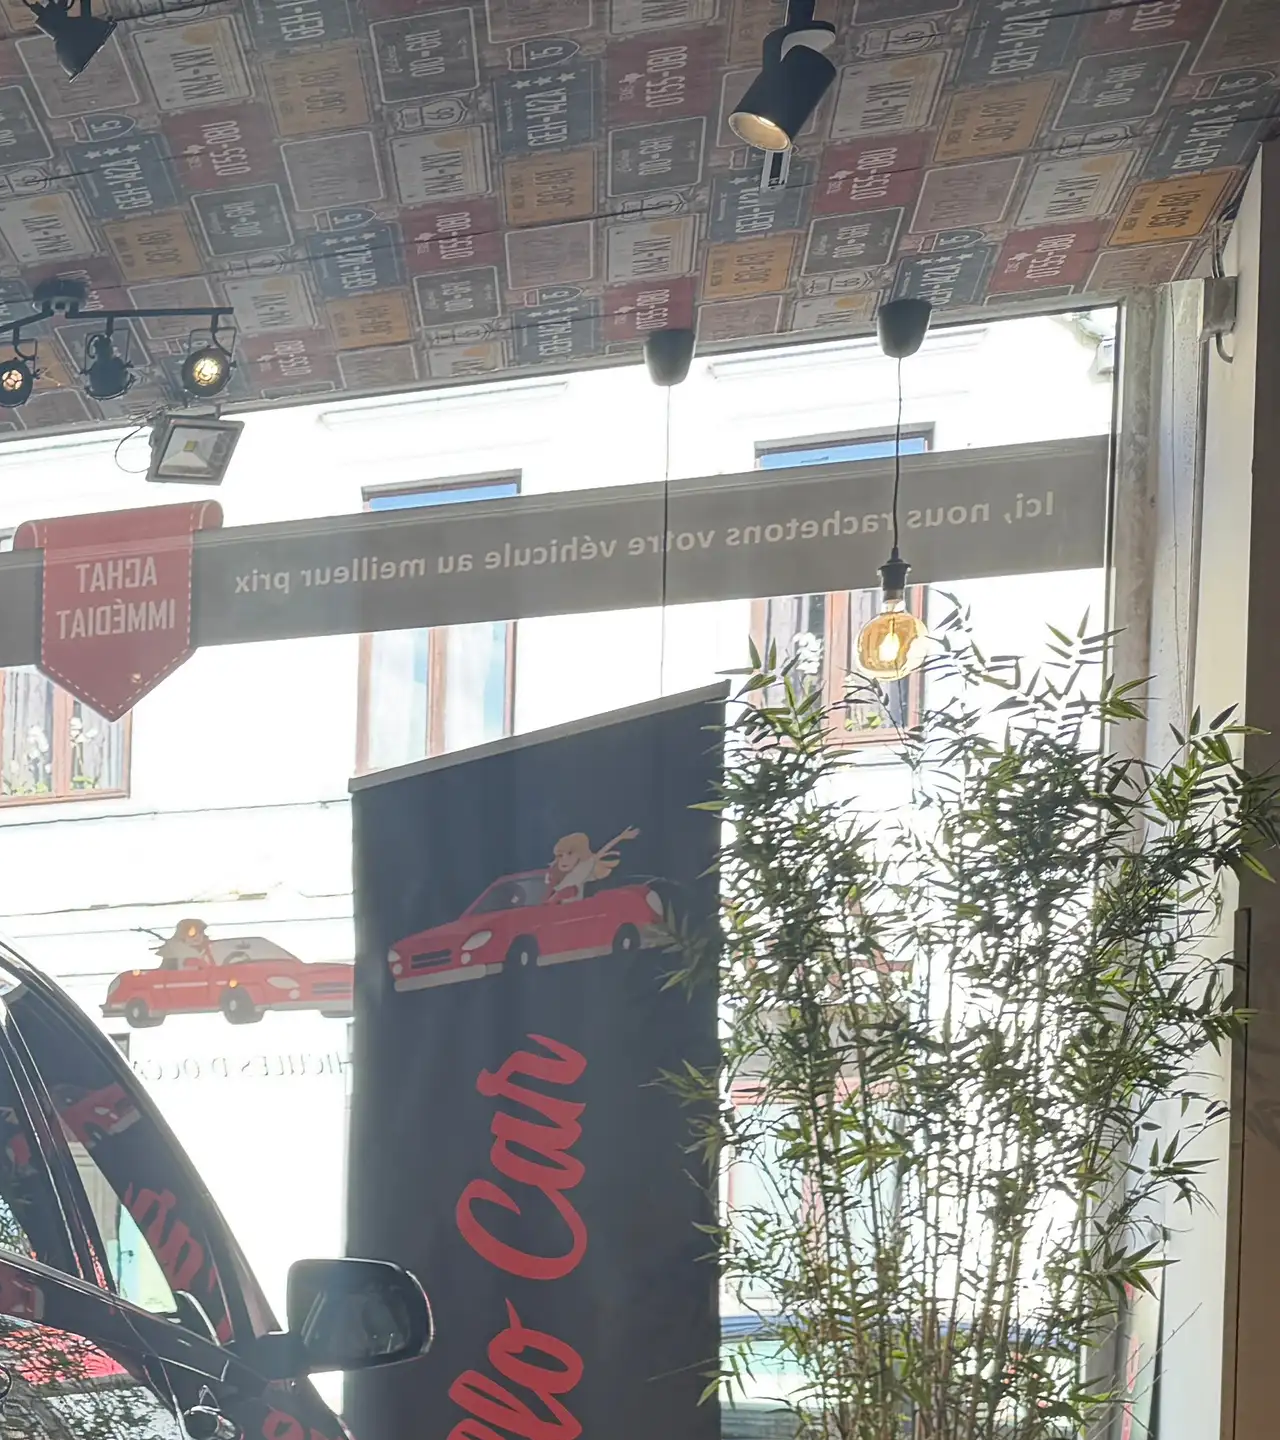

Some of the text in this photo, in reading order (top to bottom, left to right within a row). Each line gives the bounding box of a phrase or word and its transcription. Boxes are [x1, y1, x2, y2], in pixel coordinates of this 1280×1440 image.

[529, 44, 565, 60] 15
[89, 118, 124, 133] 15
[333, 212, 364, 224] 15
[938, 233, 972, 245] 15
[456, 1033, 587, 1280] Car
